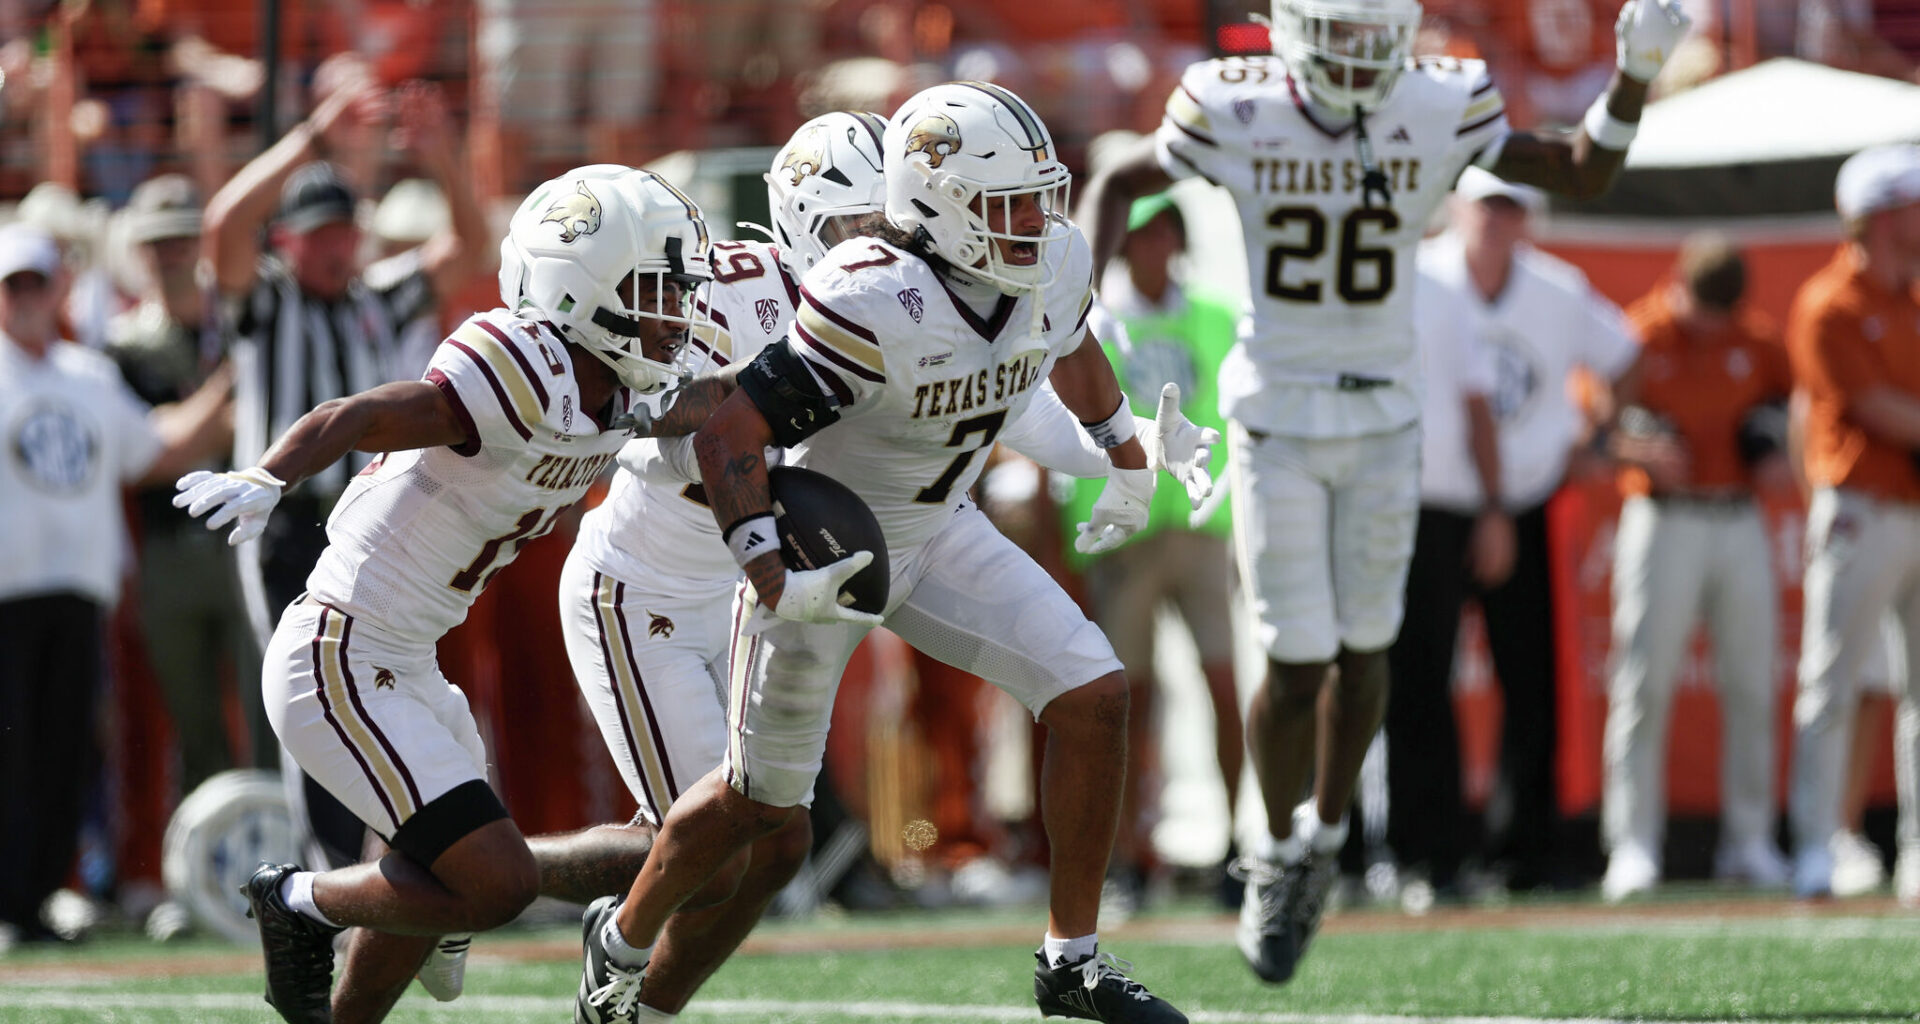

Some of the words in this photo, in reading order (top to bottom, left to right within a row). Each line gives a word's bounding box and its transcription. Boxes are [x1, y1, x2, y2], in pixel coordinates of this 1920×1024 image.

[1253, 157, 1334, 194] TEXAS
[840, 244, 901, 274] 7
[1266, 205, 1399, 304] 26
[910, 369, 988, 419] TEXAS
[993, 351, 1048, 402] STA
[910, 407, 1010, 506] 7
[819, 527, 847, 558] Texas
